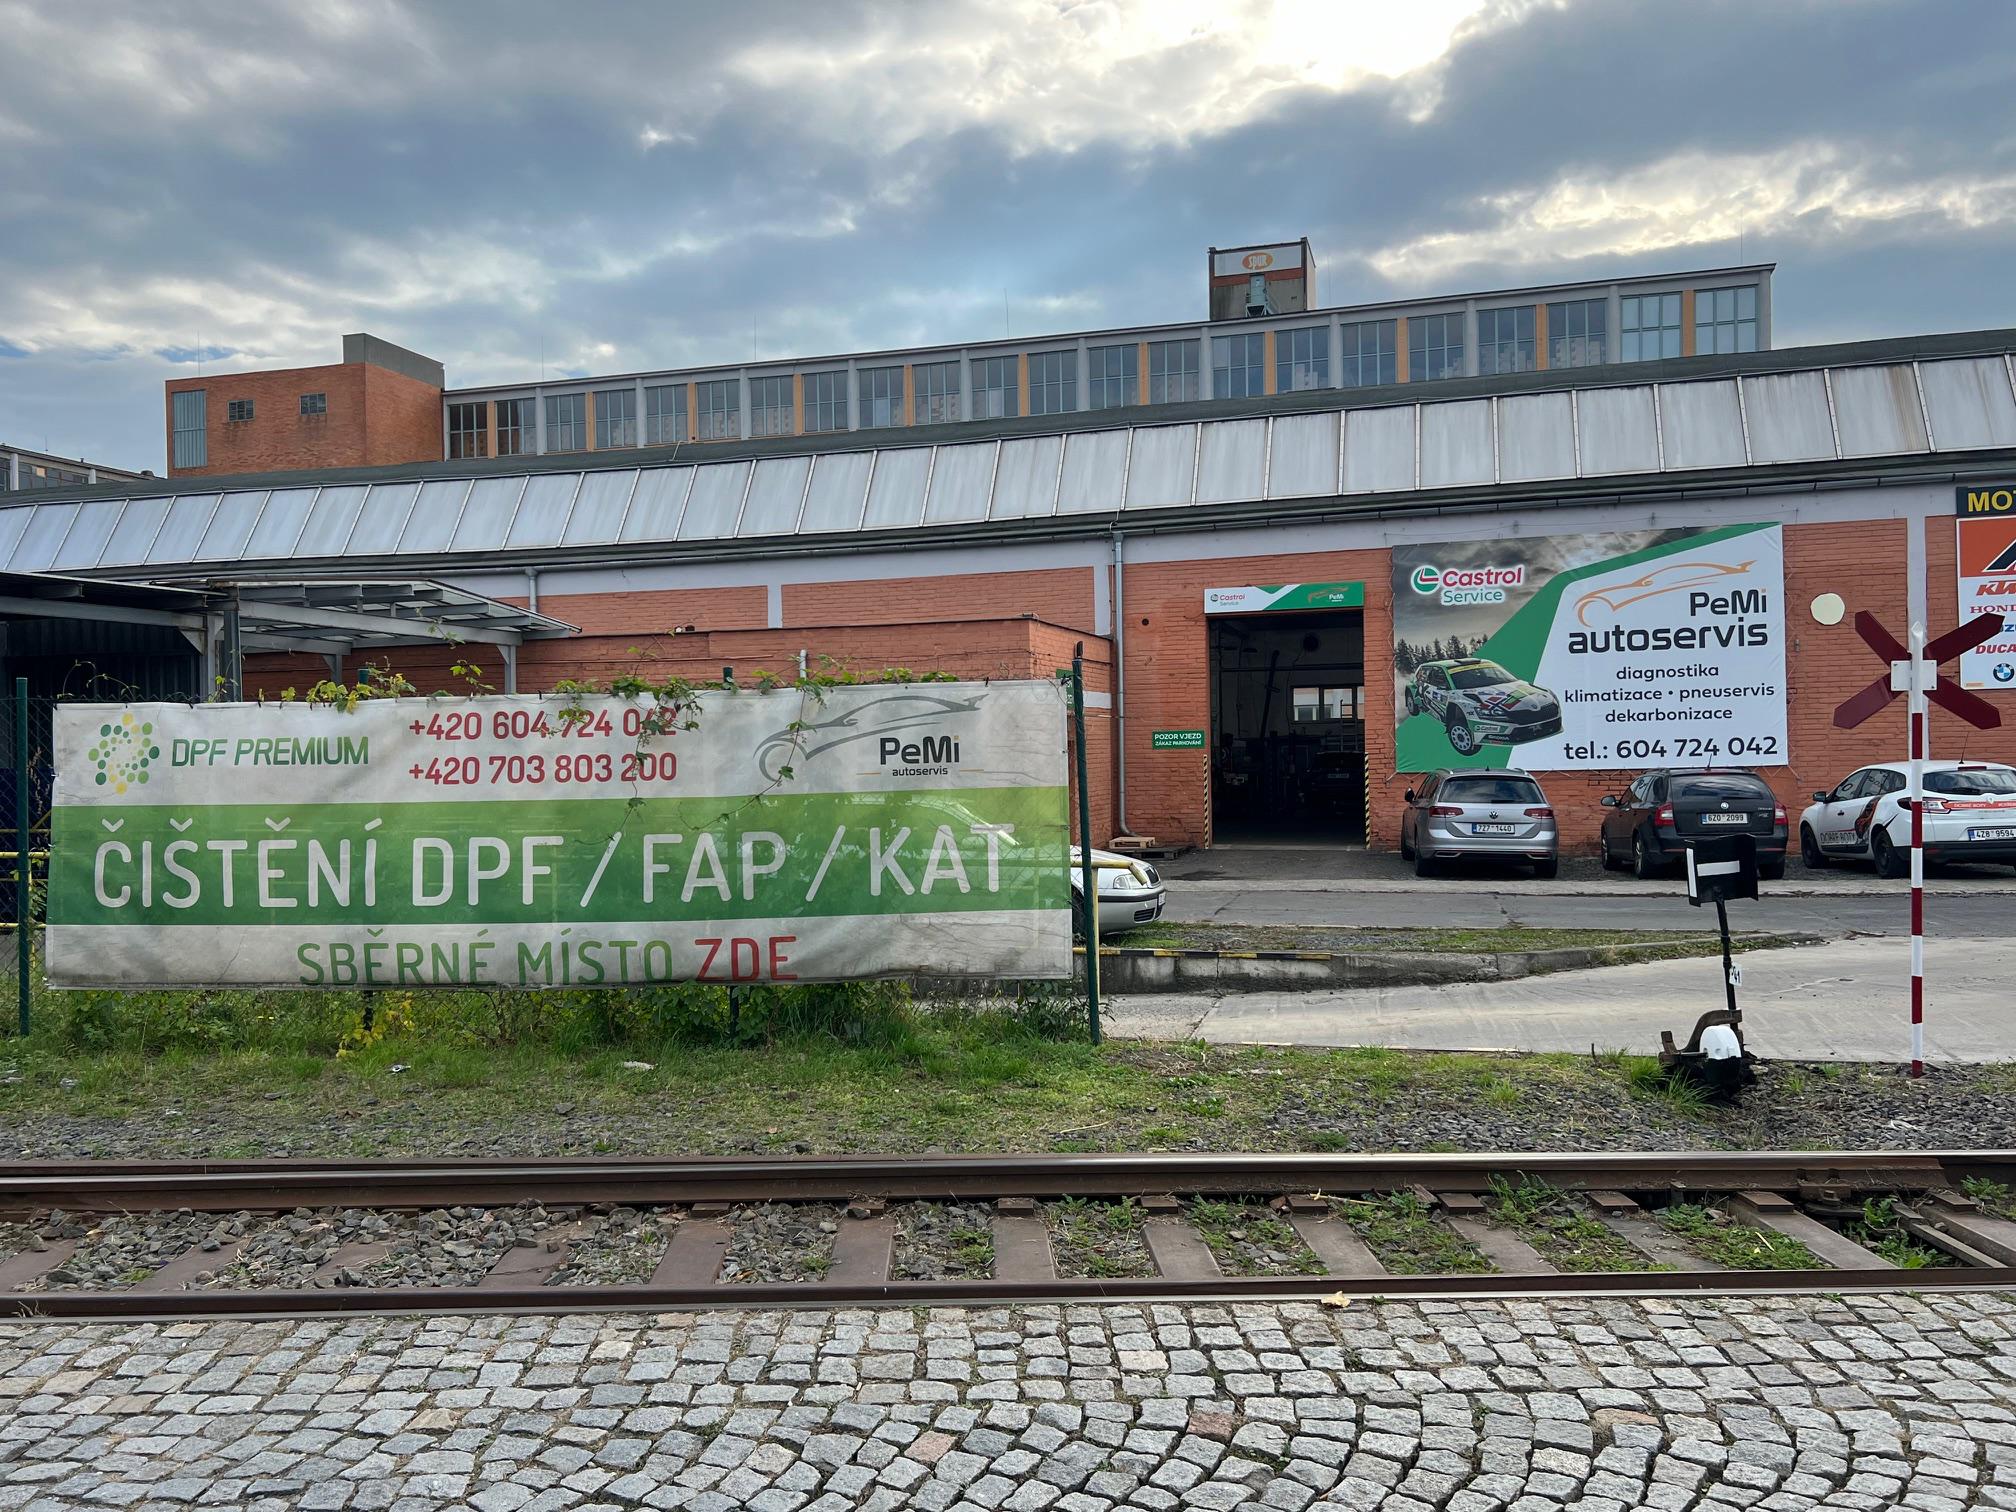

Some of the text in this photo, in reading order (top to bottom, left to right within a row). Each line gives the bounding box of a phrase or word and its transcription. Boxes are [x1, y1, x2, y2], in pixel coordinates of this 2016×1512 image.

[1967, 489, 2016, 512] MO
[1442, 566, 1522, 588] Castrol
[1442, 589, 1503, 603] Service
[1690, 589, 1767, 616] PeMi
[1568, 617, 1768, 654] autoservis
[1616, 664, 1719, 682] diagnostika
[1564, 683, 1775, 703] klimatizace pneuservis
[409, 712, 481, 740] +420
[493, 711, 549, 740] 604
[1605, 707, 1733, 723] dekarbonizace
[172, 736, 369, 767] DPF PREMIUM
[879, 734, 960, 765] PeMi
[1563, 737, 1778, 760] tel.: 604 724 042
[409, 752, 676, 785] +420 703 803 200
[892, 766, 948, 777] autoservis
[94, 817, 1015, 909] ČIŠTĚNÍ DPF / FAP / KAT
[297, 927, 798, 986] SBĚRNÉ MÍSTO ZDE
